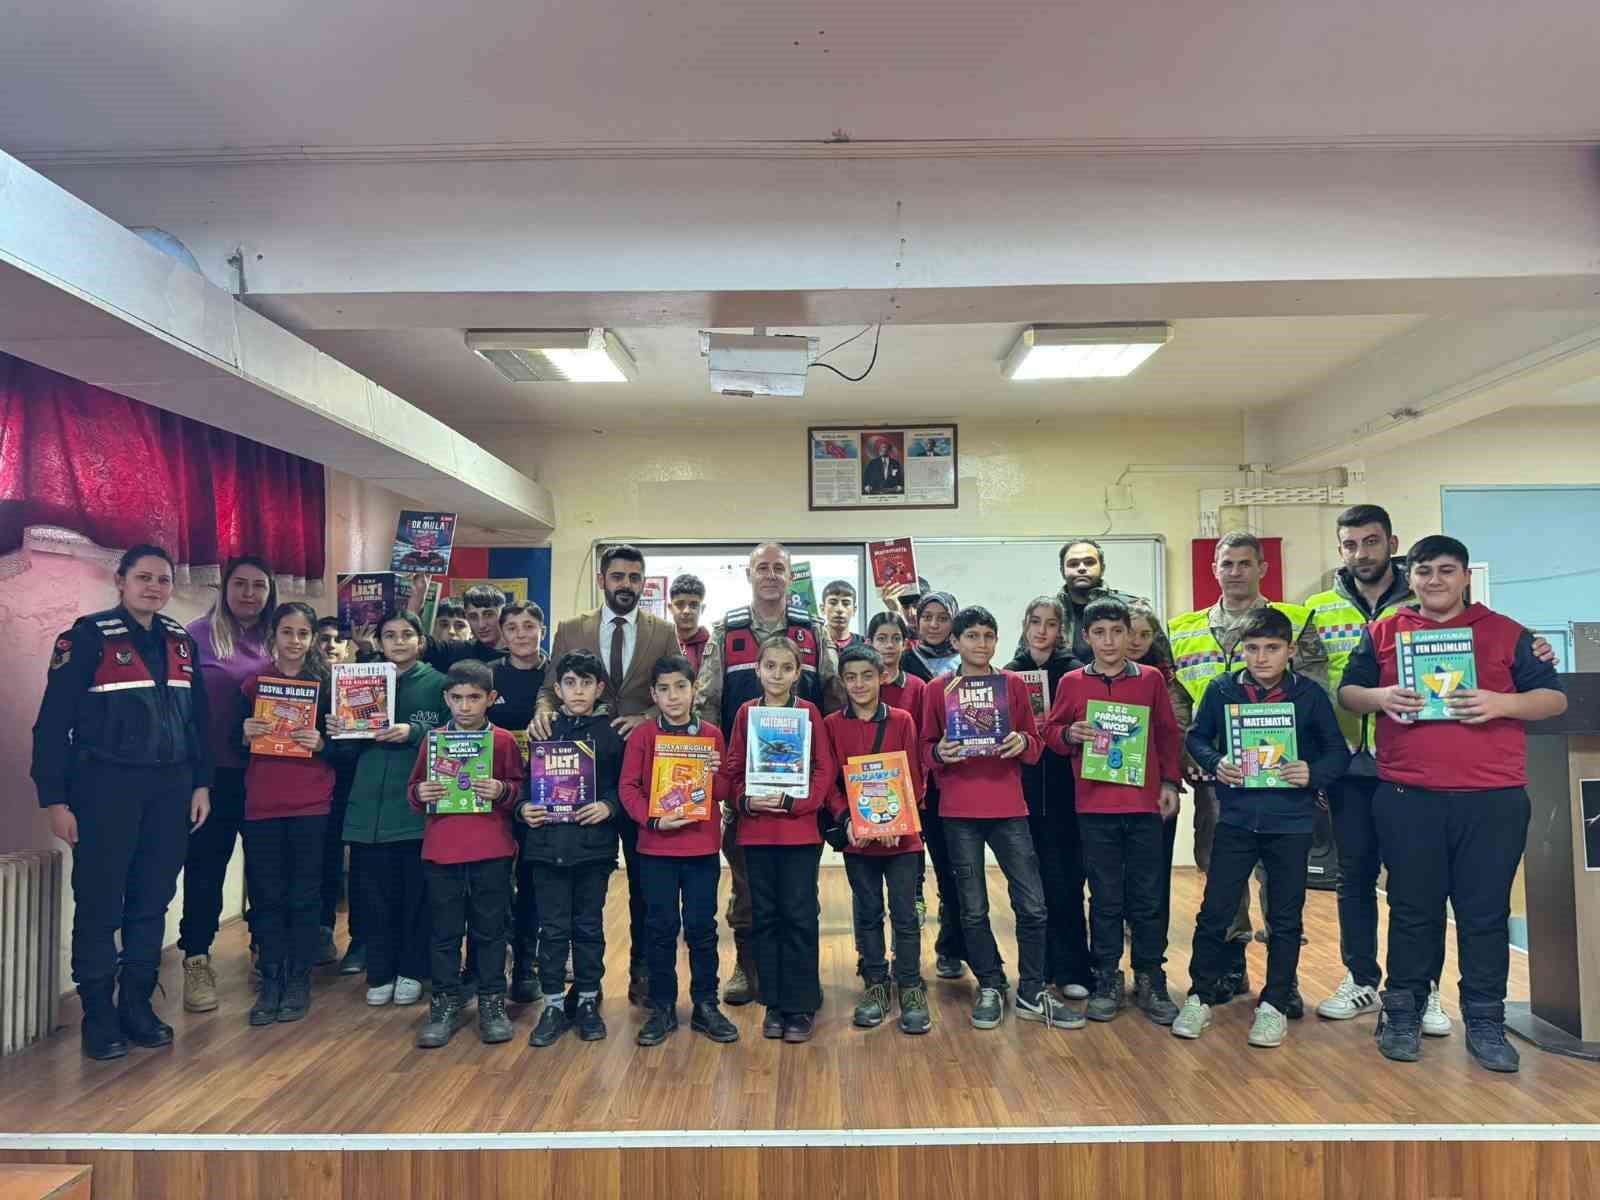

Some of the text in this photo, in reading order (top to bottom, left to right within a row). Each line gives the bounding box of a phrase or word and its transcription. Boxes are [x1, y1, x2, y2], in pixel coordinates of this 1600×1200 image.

[1435, 672, 1453, 697] 7
[1243, 715, 1292, 727] MATEMATİK
[1107, 748, 1123, 769] 8
[1258, 746, 1275, 769] 7
